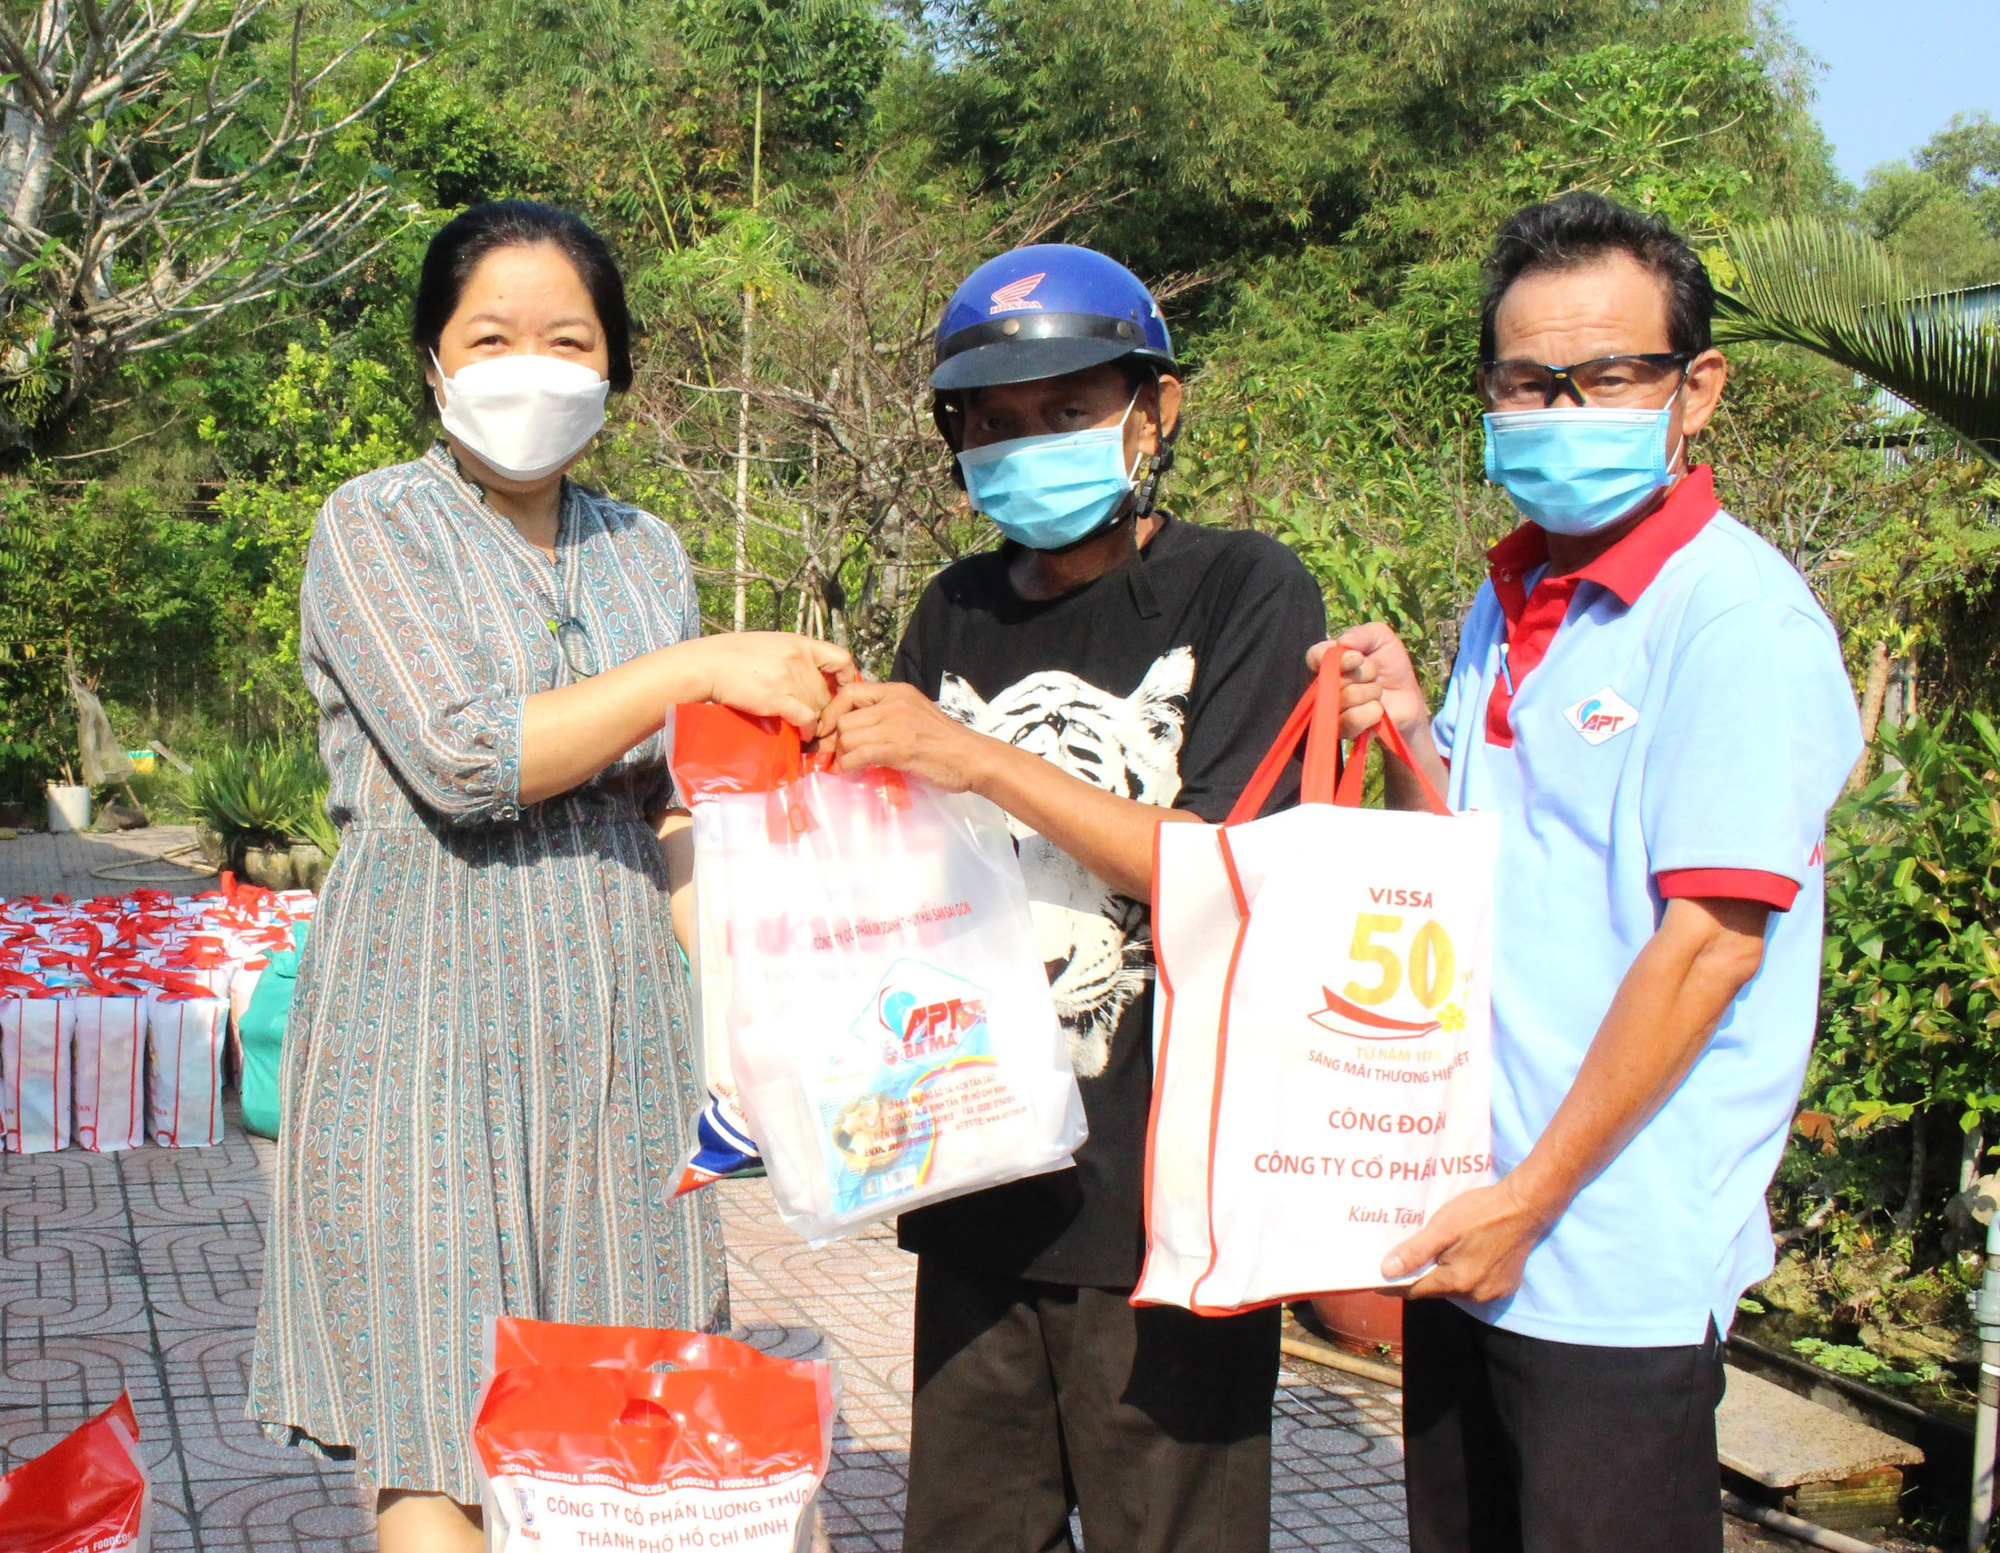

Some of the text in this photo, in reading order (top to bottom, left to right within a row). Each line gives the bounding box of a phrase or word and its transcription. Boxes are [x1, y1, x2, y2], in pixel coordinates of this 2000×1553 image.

[990, 302, 1043, 314] HONDA
[1581, 714, 1624, 732] APT
[1368, 886, 1433, 909] VISSA
[1342, 912, 1455, 1009] 50
[902, 998, 962, 1043] APT
[1307, 1048, 1341, 1072] SÁNG
[1343, 1061, 1372, 1080] MÃI
[1374, 1067, 1430, 1085] THƯƠNG
[1328, 1106, 1392, 1134] CÔNG
[1253, 1149, 1315, 1175] CÔNG
[1320, 1155, 1346, 1177] TY
[1351, 1154, 1384, 1179] CỔ
[1347, 1204, 1389, 1225] Kính
[534, 1468, 579, 1484] FOODCOSA
[582, 1472, 625, 1489] FOODCOSA
[626, 1480, 669, 1495] FOODCOSA
[671, 1475, 716, 1490] FOODCOSA
[718, 1476, 766, 1490] FOODCOSA
[546, 1495, 595, 1518] CÔNG
[599, 1501, 620, 1518] TY
[624, 1502, 645, 1527] CỔ
[649, 1499, 698, 1528] PHẦN
[702, 1498, 762, 1522] LƯƠNG
[577, 1517, 790, 1553] THÀNH PHỐ HỒ CHÍ MINH
